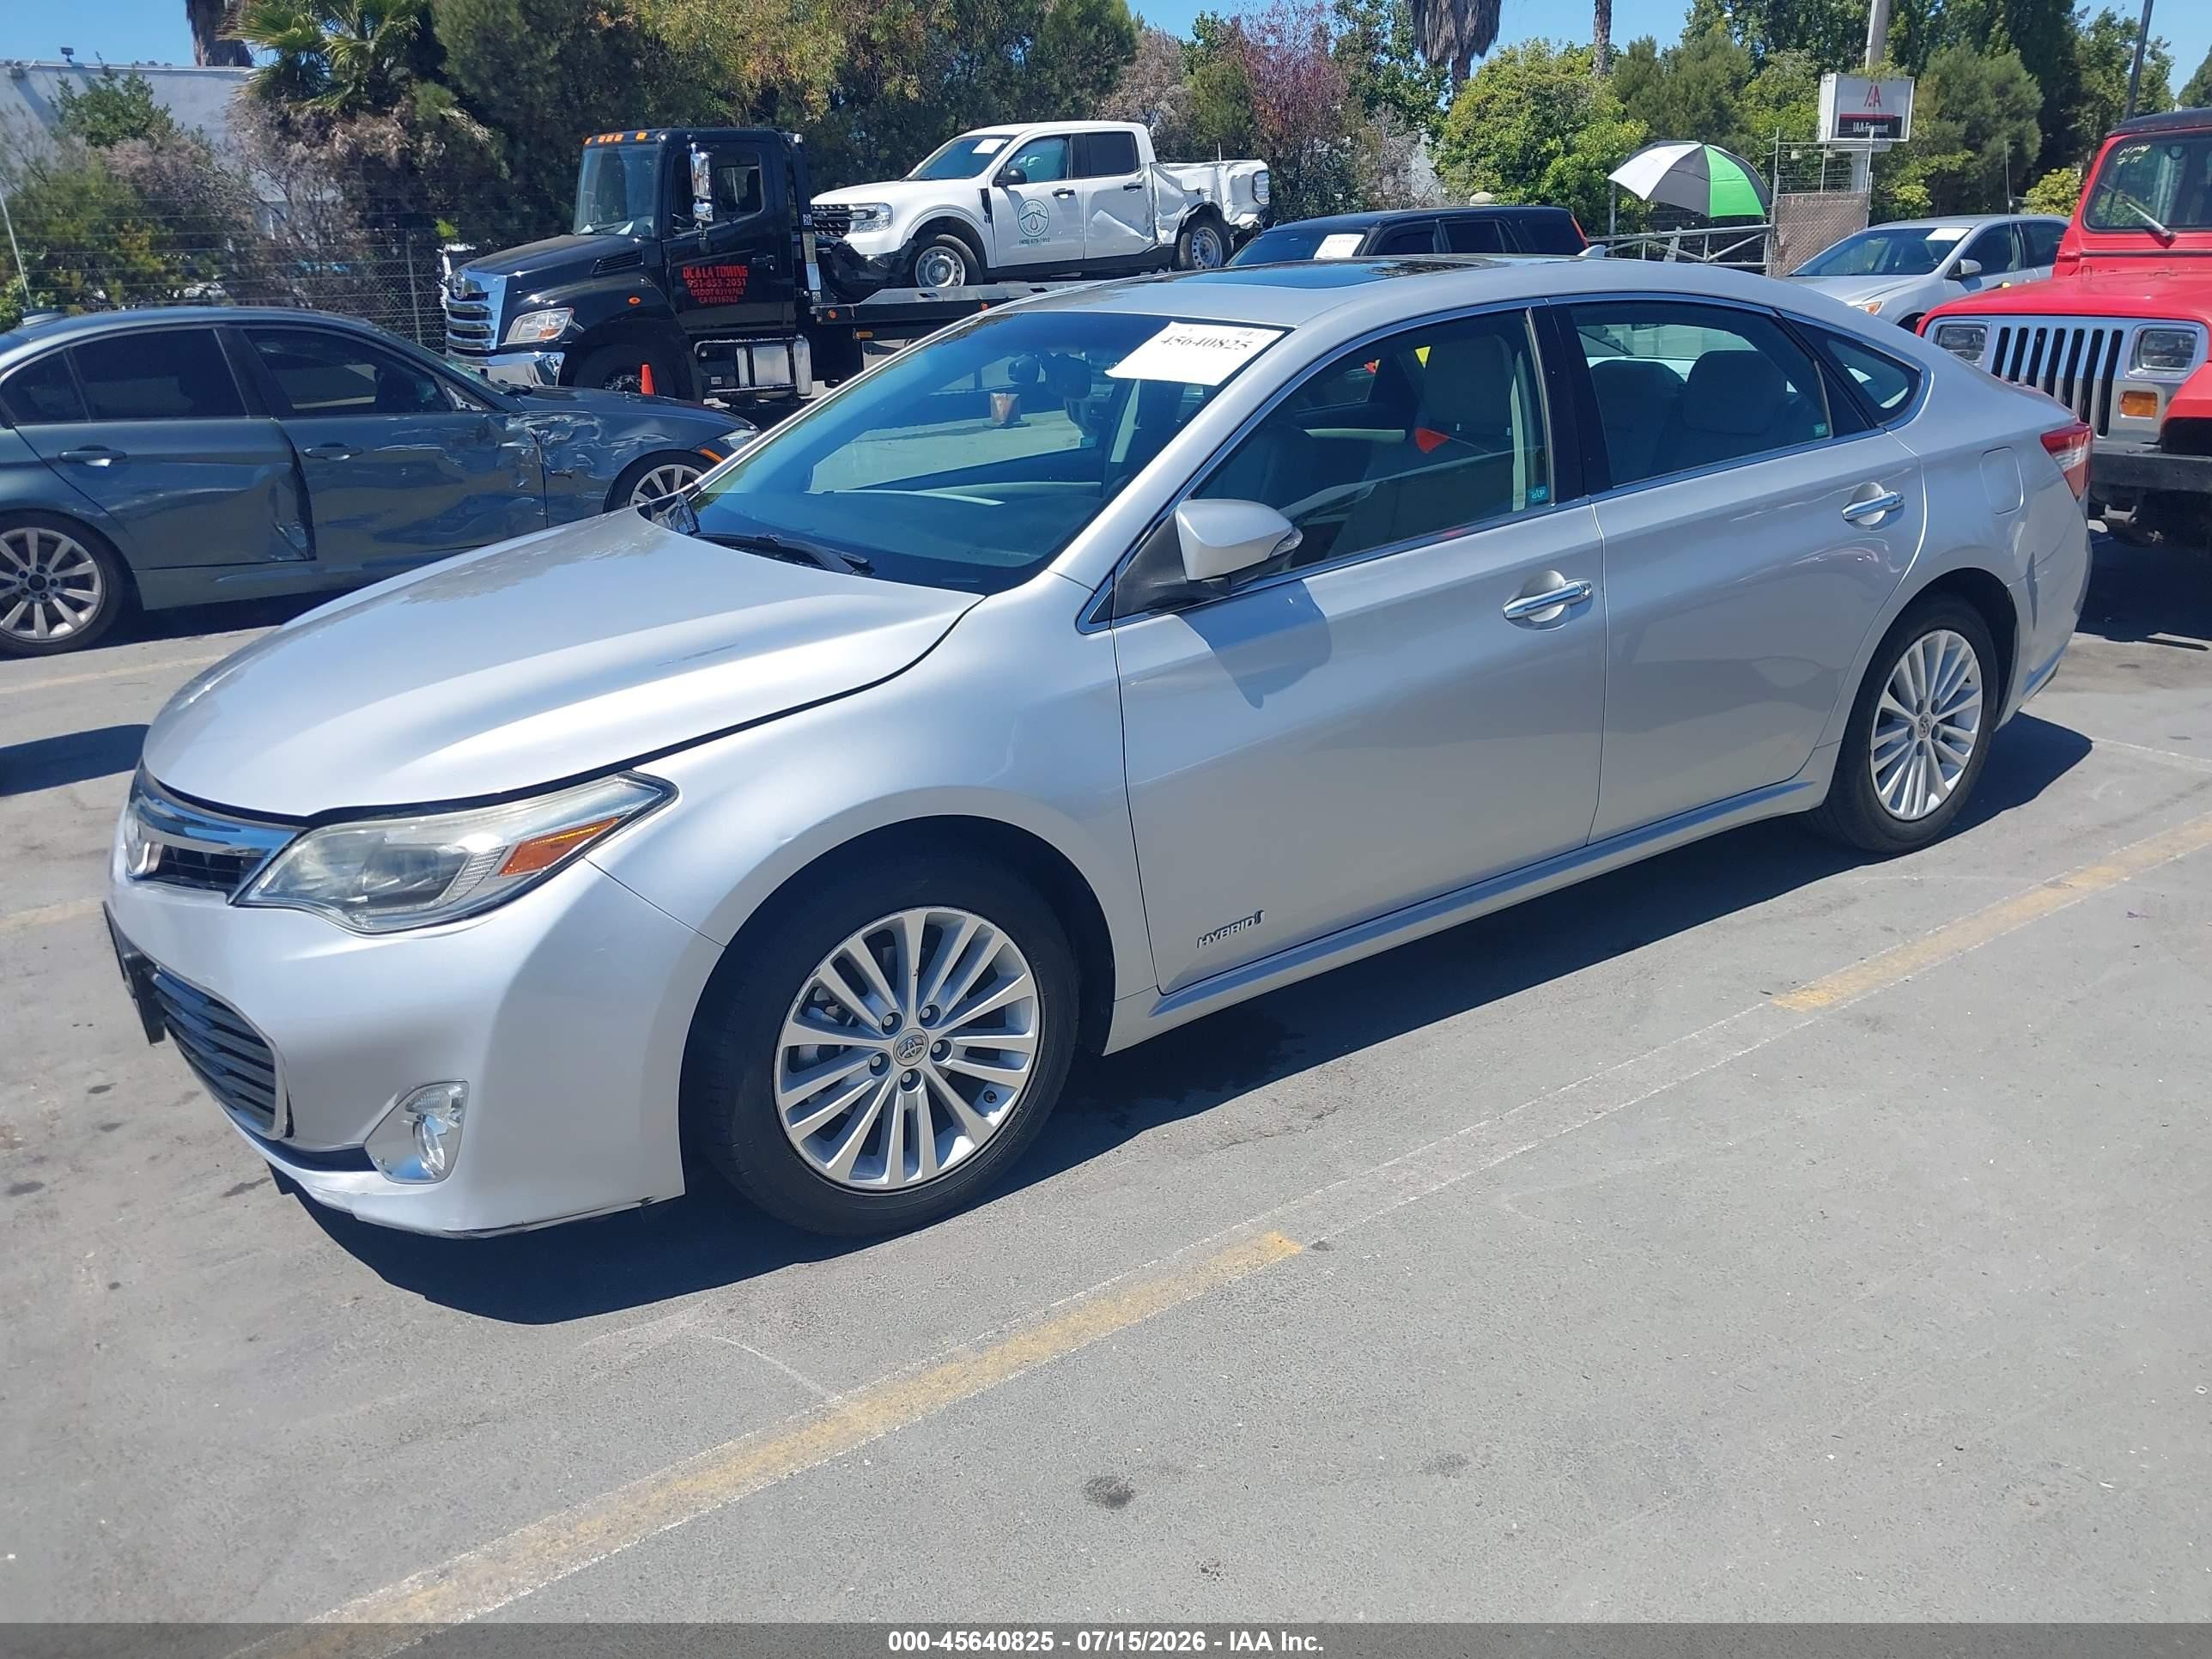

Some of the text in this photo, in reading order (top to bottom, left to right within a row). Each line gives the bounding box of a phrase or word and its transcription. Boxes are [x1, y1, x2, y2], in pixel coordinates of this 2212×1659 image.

[714, 265, 749, 277] TOWING
[690, 288, 714, 296] USDOT
[1161, 335, 1254, 350] 45640825
[1196, 915, 1255, 949] HYBRID
